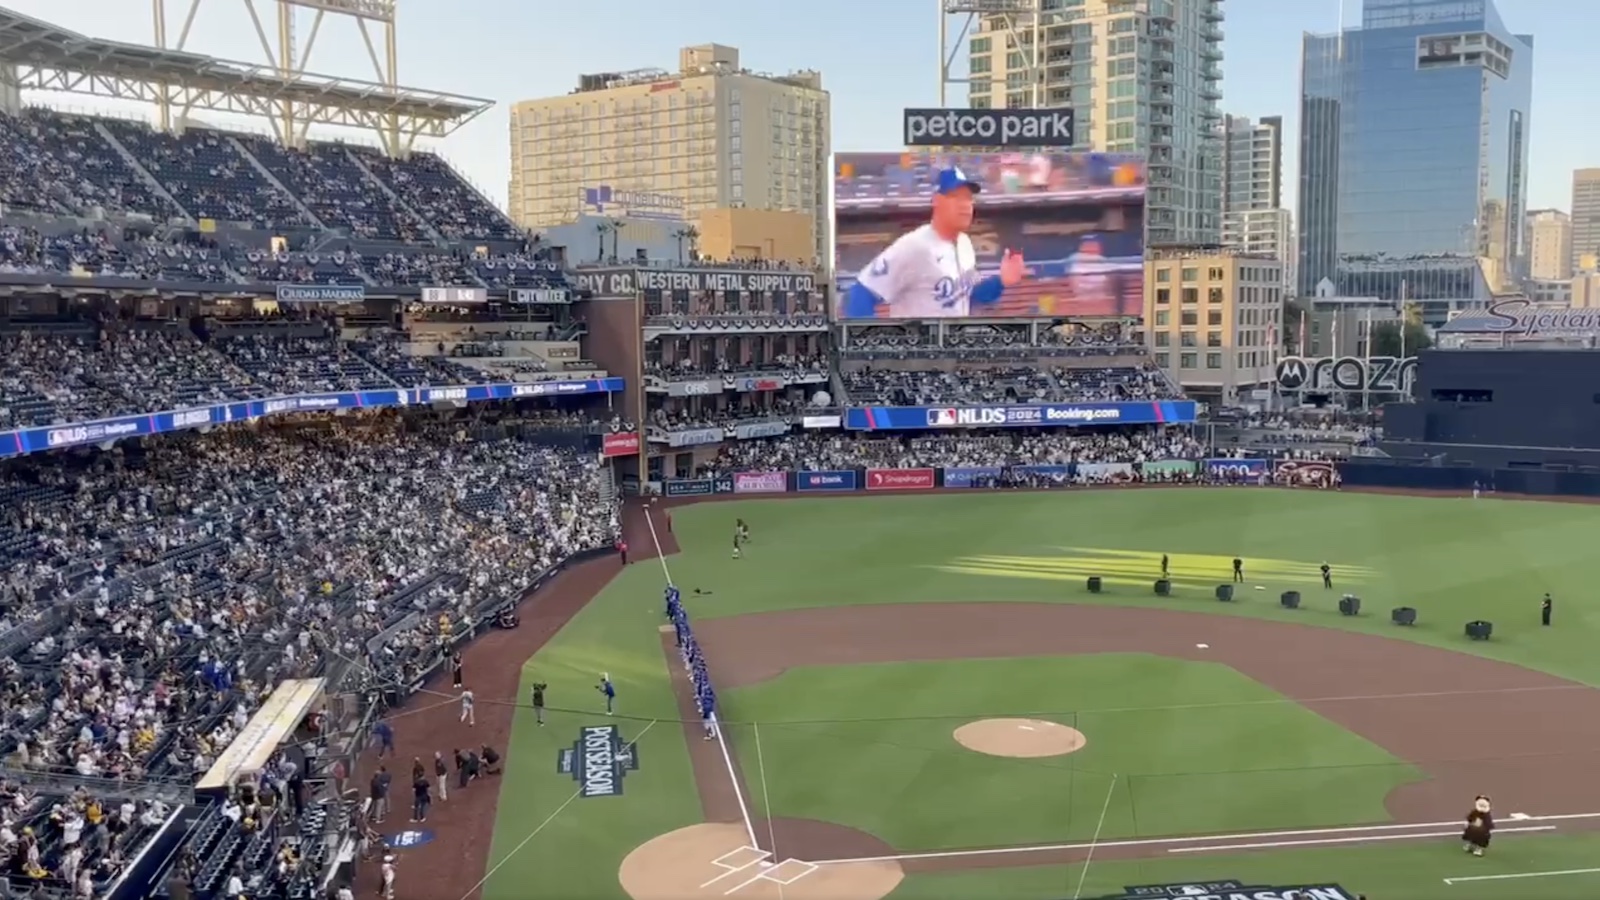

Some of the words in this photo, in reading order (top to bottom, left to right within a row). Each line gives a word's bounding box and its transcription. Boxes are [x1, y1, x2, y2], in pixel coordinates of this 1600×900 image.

[907, 111, 996, 143] petco
[1001, 113, 1070, 143] park
[637, 271, 700, 290] WESTERN
[705, 273, 745, 291] METAL
[748, 275, 791, 291] SUPPLY
[1313, 356, 1419, 391] razr
[957, 408, 1006, 424] NLDS
[1007, 411, 1042, 420] 2024
[1047, 408, 1119, 420] Booking.com
[715, 481, 731, 492] 342
[822, 475, 843, 484] bank
[585, 726, 614, 796] POSTSEASON
